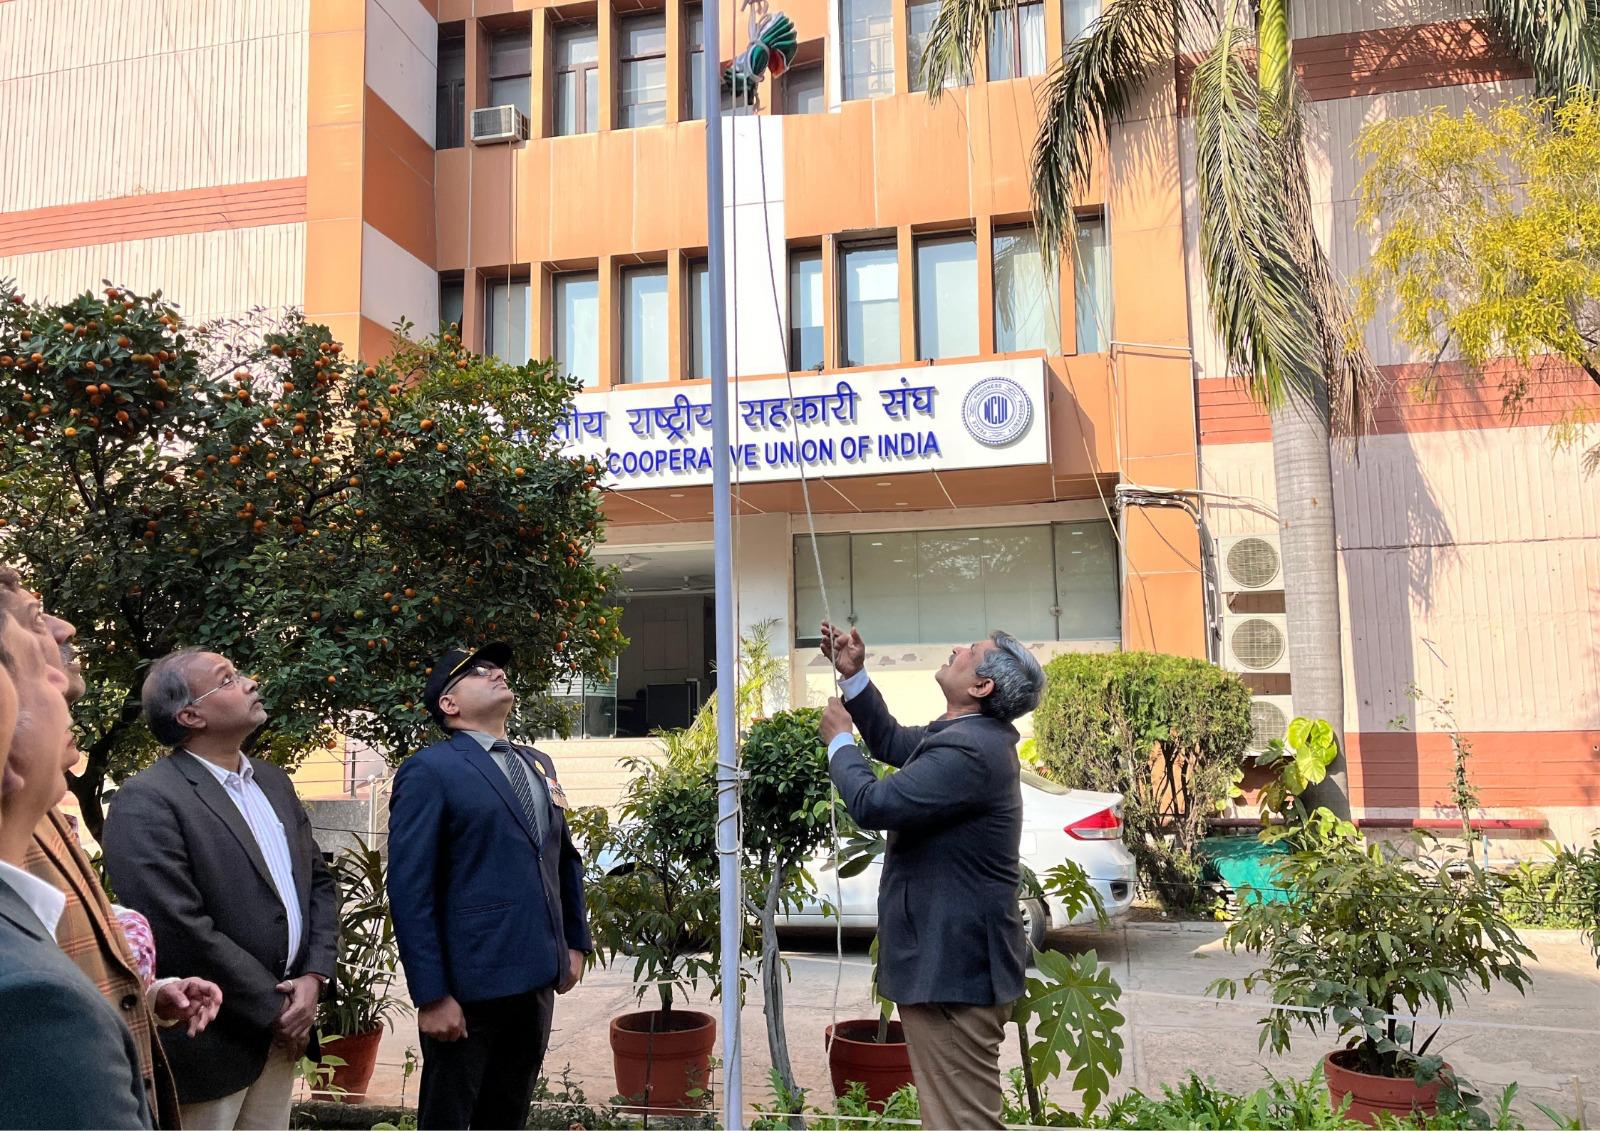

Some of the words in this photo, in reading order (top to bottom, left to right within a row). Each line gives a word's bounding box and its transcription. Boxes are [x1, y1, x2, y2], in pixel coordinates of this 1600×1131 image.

[626, 393, 712, 440] राष्ट्रीय
[739, 381, 857, 427] सहकारी
[879, 377, 935, 417] संघ
[984, 395, 1007, 424] NCUI
[608, 443, 757, 475] COOPERAVE
[765, 438, 833, 465] UNION
[840, 435, 870, 460] OF
[878, 431, 940, 457] INDIA
